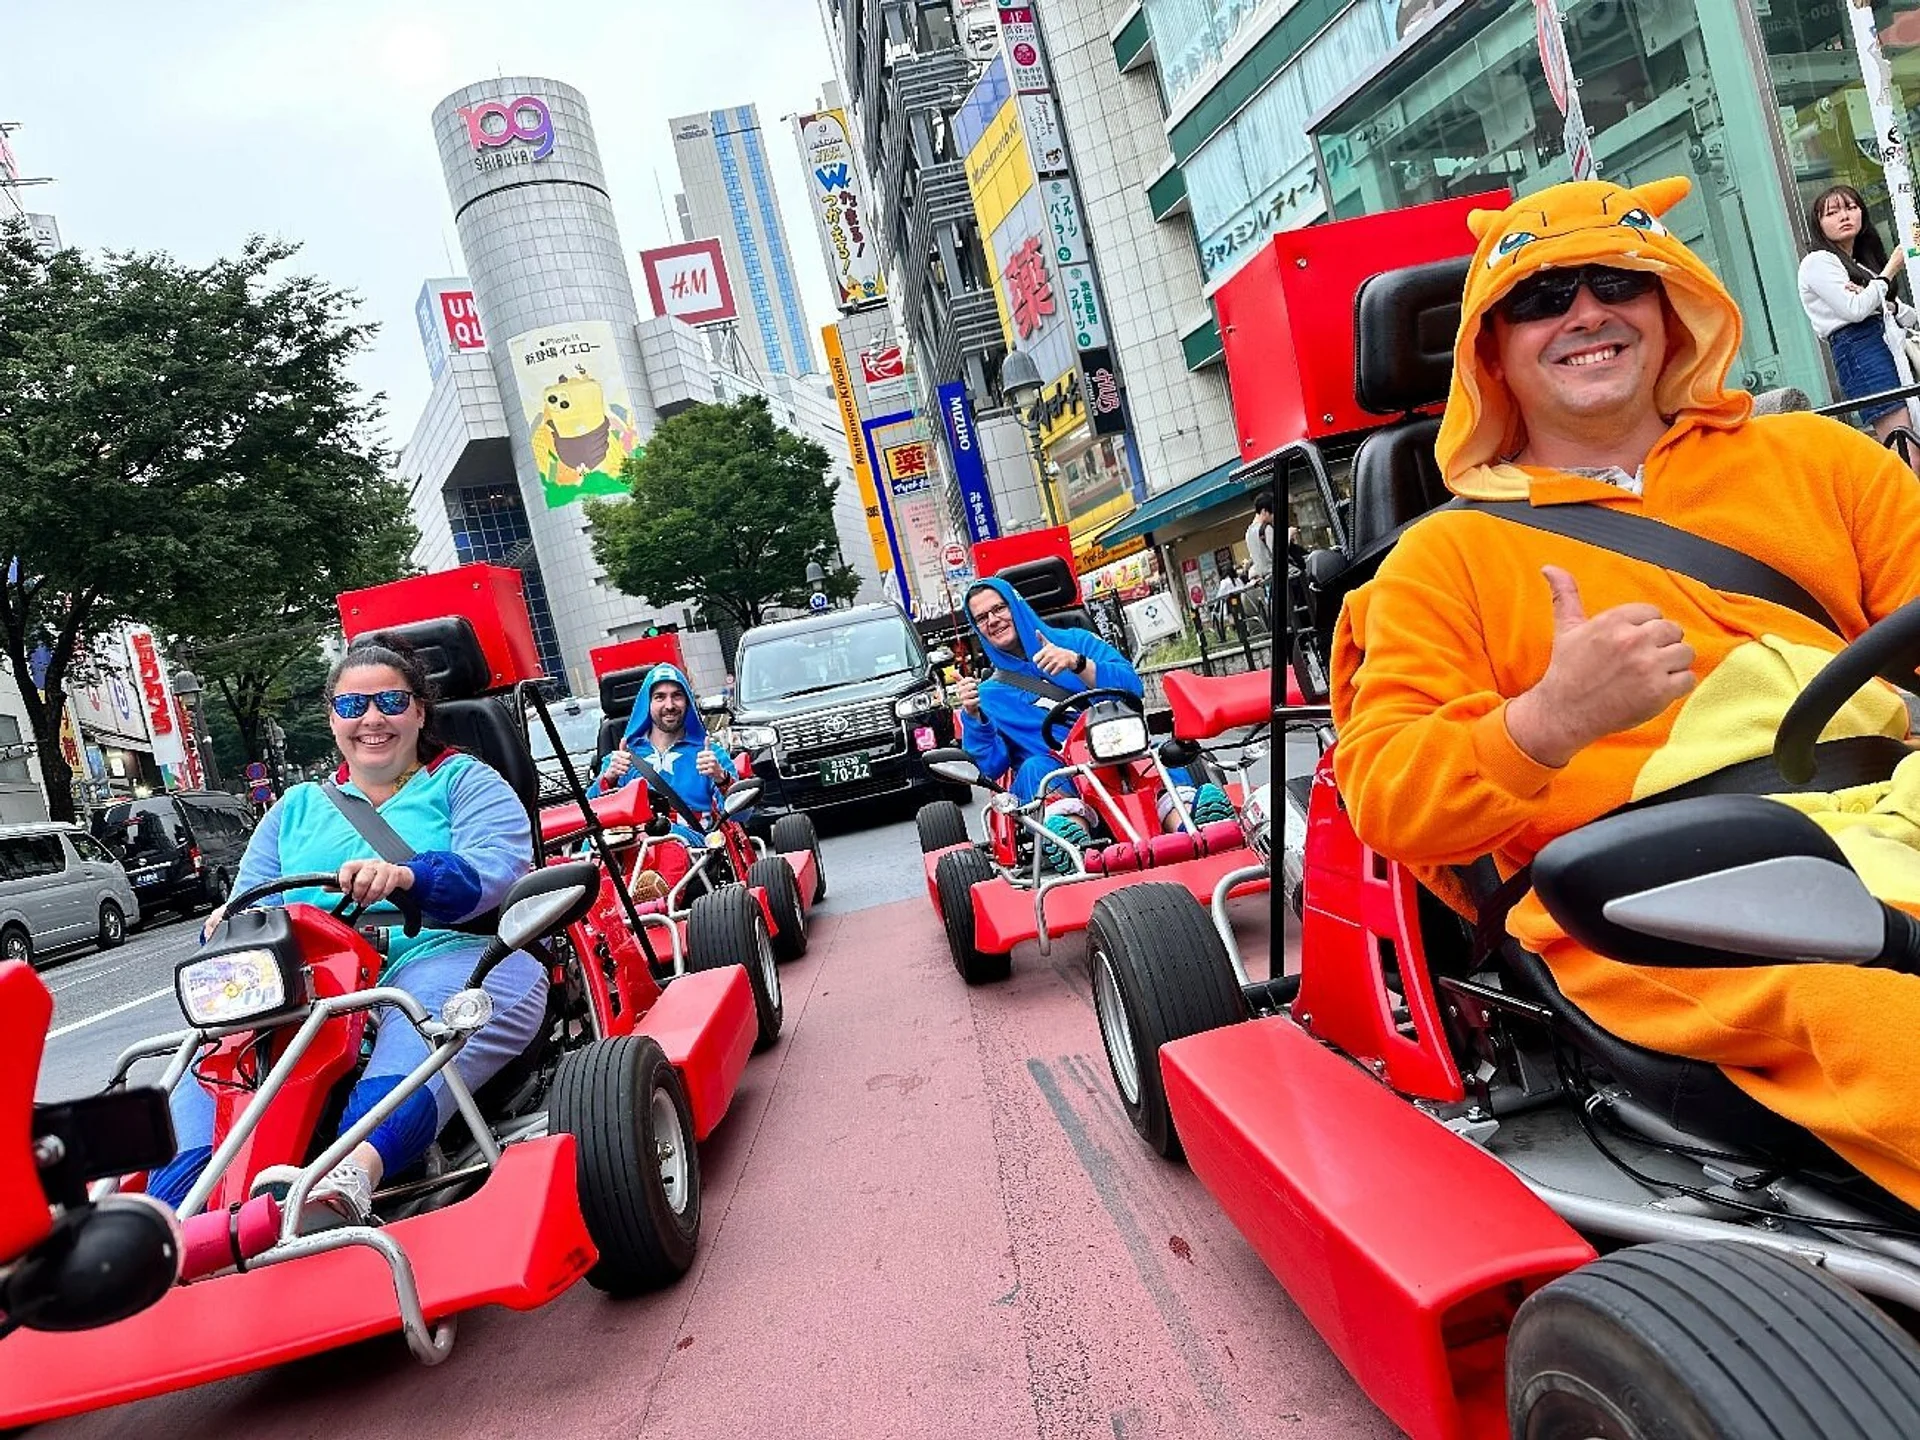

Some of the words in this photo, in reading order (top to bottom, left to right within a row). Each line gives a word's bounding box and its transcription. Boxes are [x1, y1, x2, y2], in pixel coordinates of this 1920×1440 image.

[455, 96, 554, 161] 109
[474, 150, 530, 172] SHIBUYA
[1050, 202, 1065, 245] パーラー
[1061, 195, 1078, 238] フルーツ
[668, 267, 708, 300] H&M
[1005, 235, 1057, 341] 薬
[1069, 288, 1086, 331] フルーツ
[949, 397, 969, 451] MIZUHO
[893, 445, 927, 476] 薬
[969, 491, 991, 543] みずほ銀
[831, 764, 870, 783] 70-22
